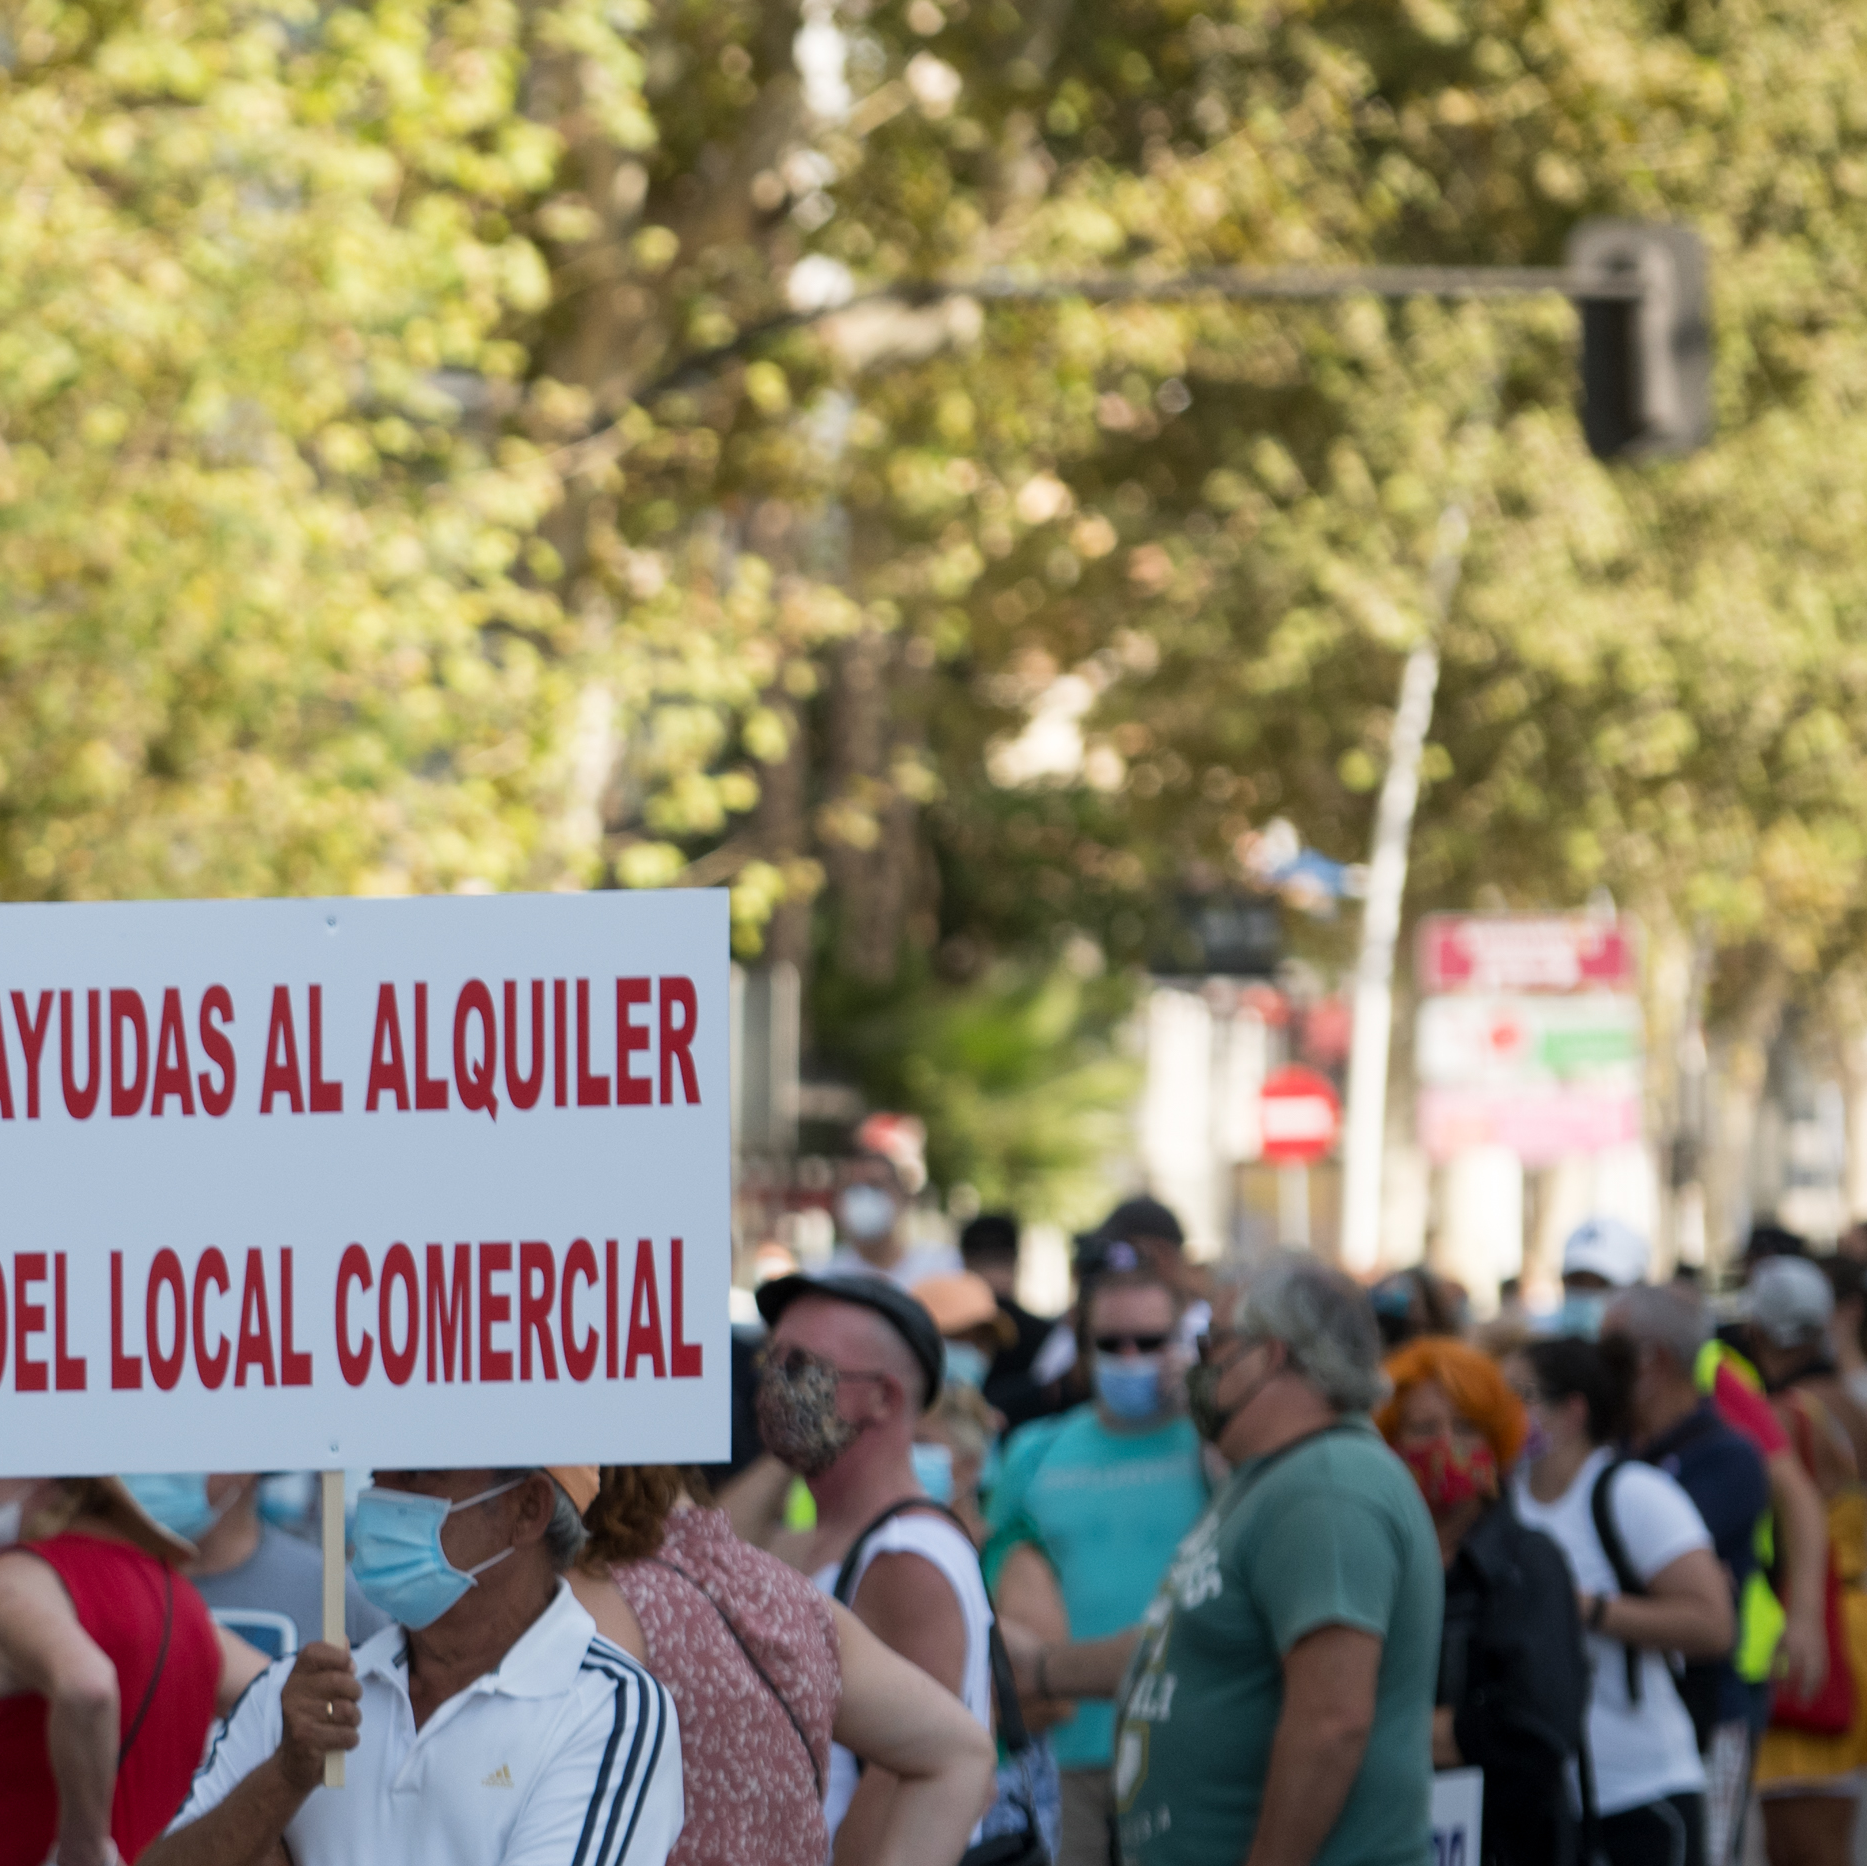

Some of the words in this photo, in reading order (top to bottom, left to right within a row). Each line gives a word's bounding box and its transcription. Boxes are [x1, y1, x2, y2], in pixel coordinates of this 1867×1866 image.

[261, 986, 342, 1113] AL
[366, 977, 700, 1119] ALQUILER
[111, 1248, 312, 1391] LOCAL
[336, 1240, 702, 1387] COMERCIAL
